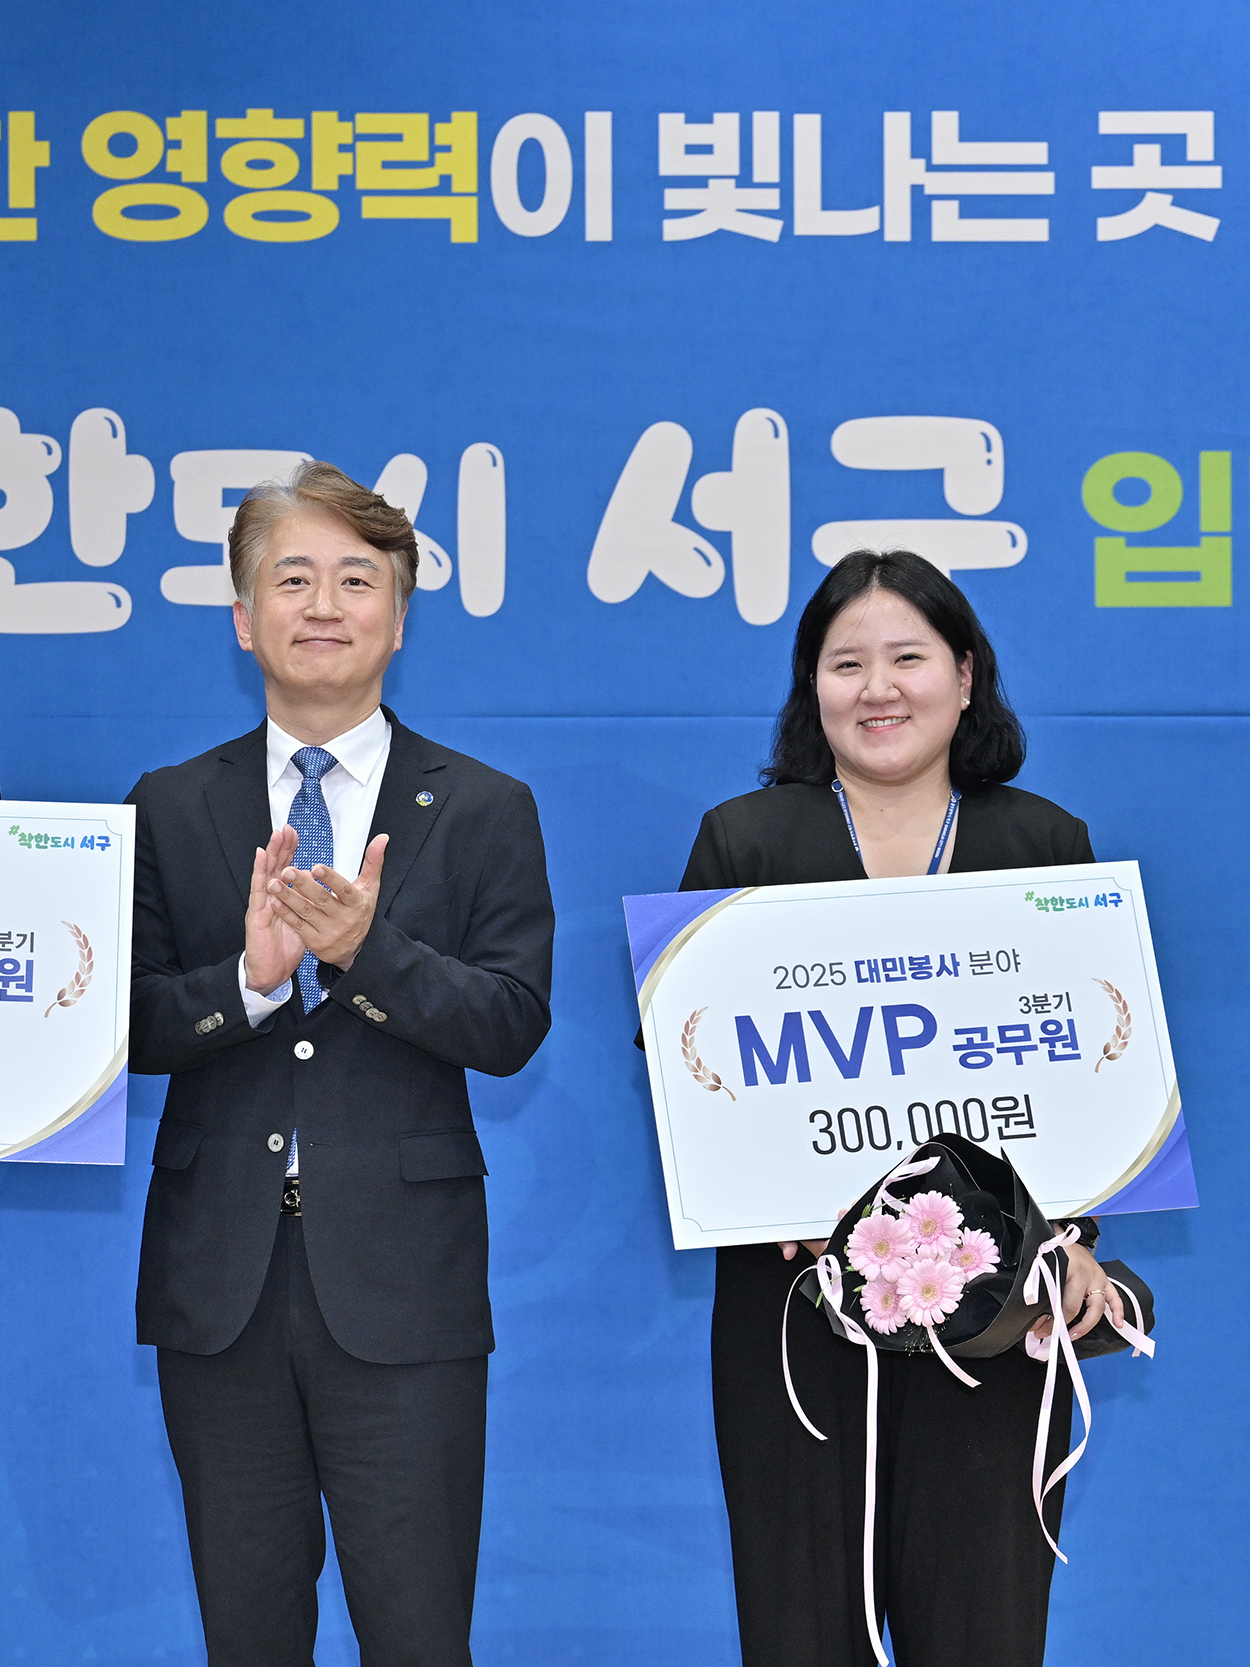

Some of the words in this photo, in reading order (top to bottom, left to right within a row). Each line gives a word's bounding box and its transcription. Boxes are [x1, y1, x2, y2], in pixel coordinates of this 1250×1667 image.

[81, 108, 612, 243] 영향력이
[658, 111, 1055, 243] 빛나는
[1091, 111, 1222, 243] 곳
[587, 408, 1028, 626] 서구
[8, 825, 75, 849] #착한도시
[80, 835, 111, 851] 서구
[1025, 891, 1089, 912] #착한도시
[1094, 893, 1123, 907] 서구
[773, 962, 846, 989] 2025
[854, 953, 960, 983] 대민봉사
[969, 949, 1021, 975] 분야
[1019, 992, 1072, 1014] 3분기
[735, 1004, 937, 1087] MVP
[952, 1019, 1081, 1069] 공무원
